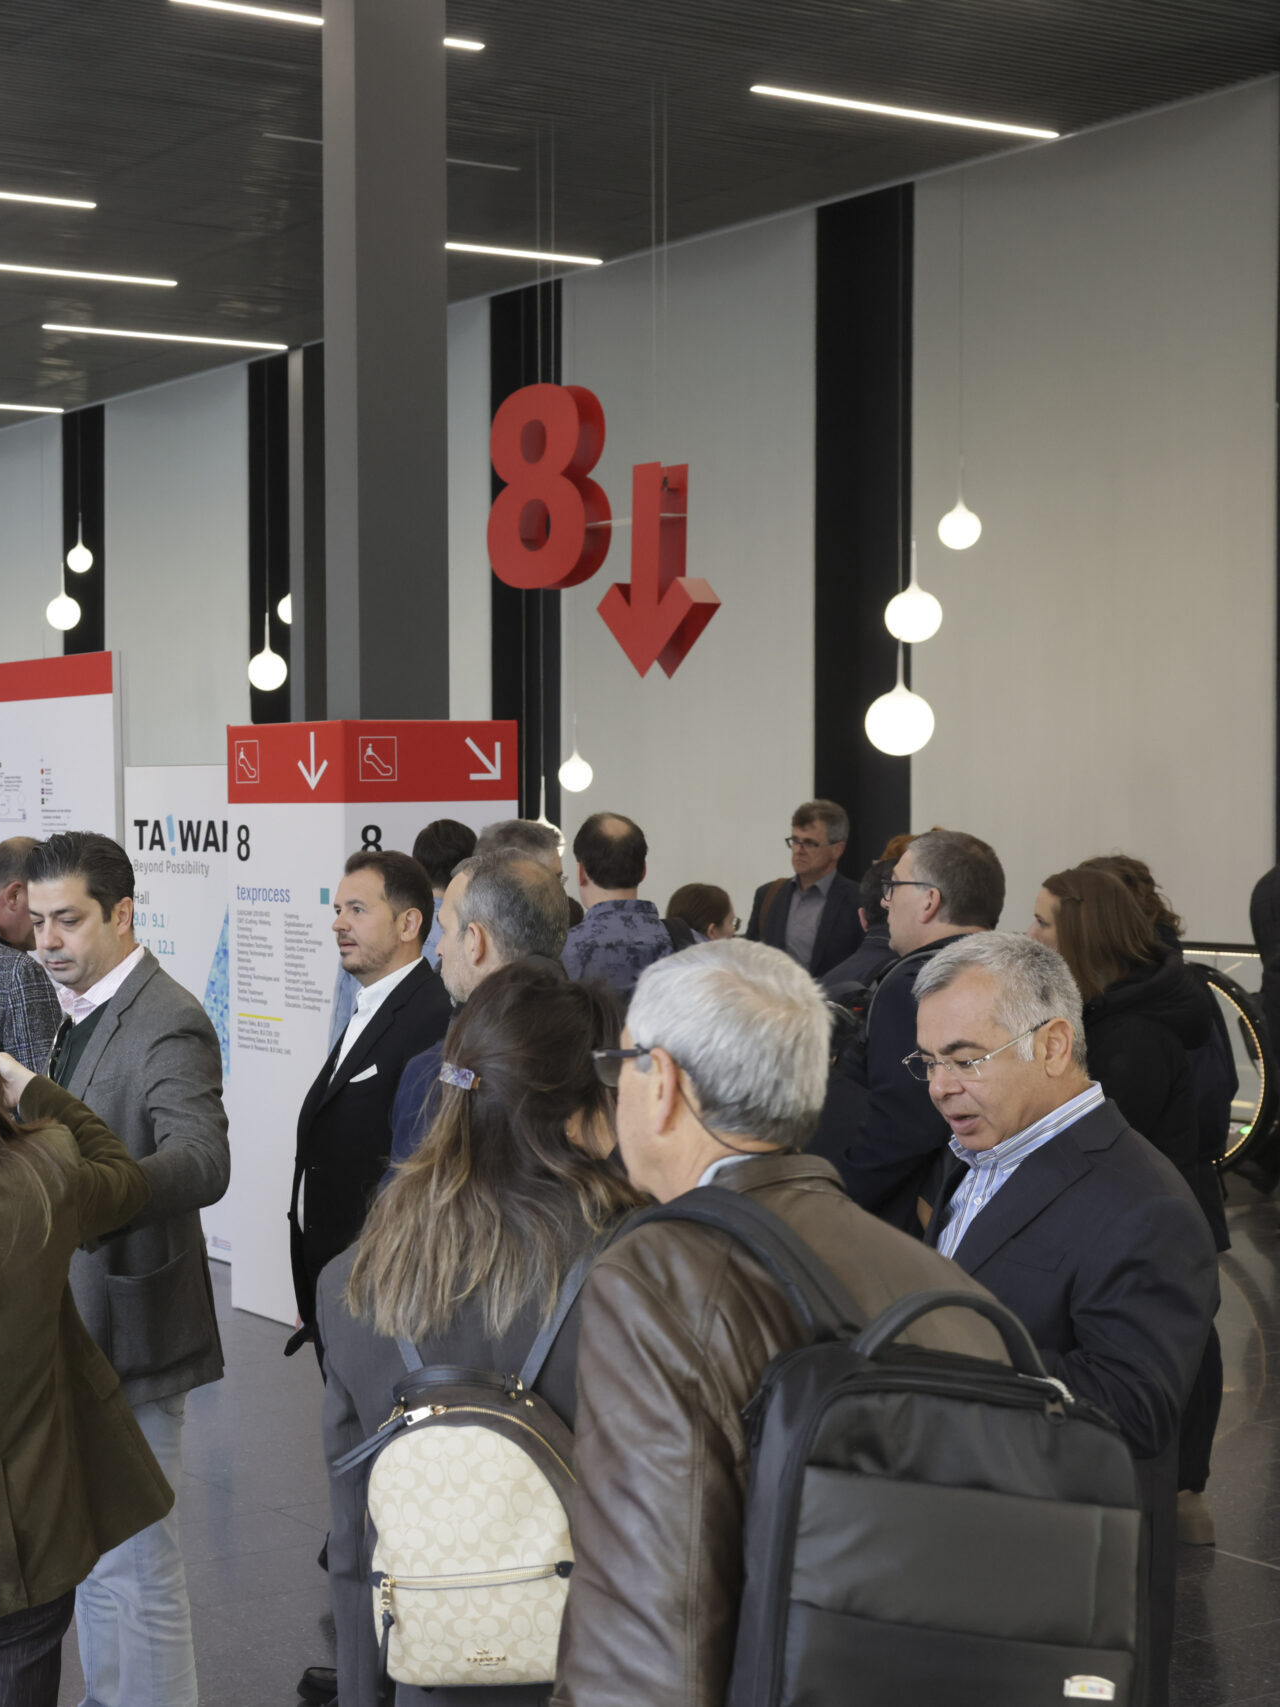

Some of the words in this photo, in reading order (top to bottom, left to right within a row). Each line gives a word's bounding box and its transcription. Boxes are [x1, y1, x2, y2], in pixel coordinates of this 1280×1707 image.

[487, 383, 612, 590] 8
[237, 824, 250, 861] 8
[133, 859, 163, 875] Beyond
[166, 861, 210, 878] Possibility
[237, 884, 290, 904] texprocess
[152, 913, 165, 928] 9.1
[158, 939, 175, 954] 12.1
